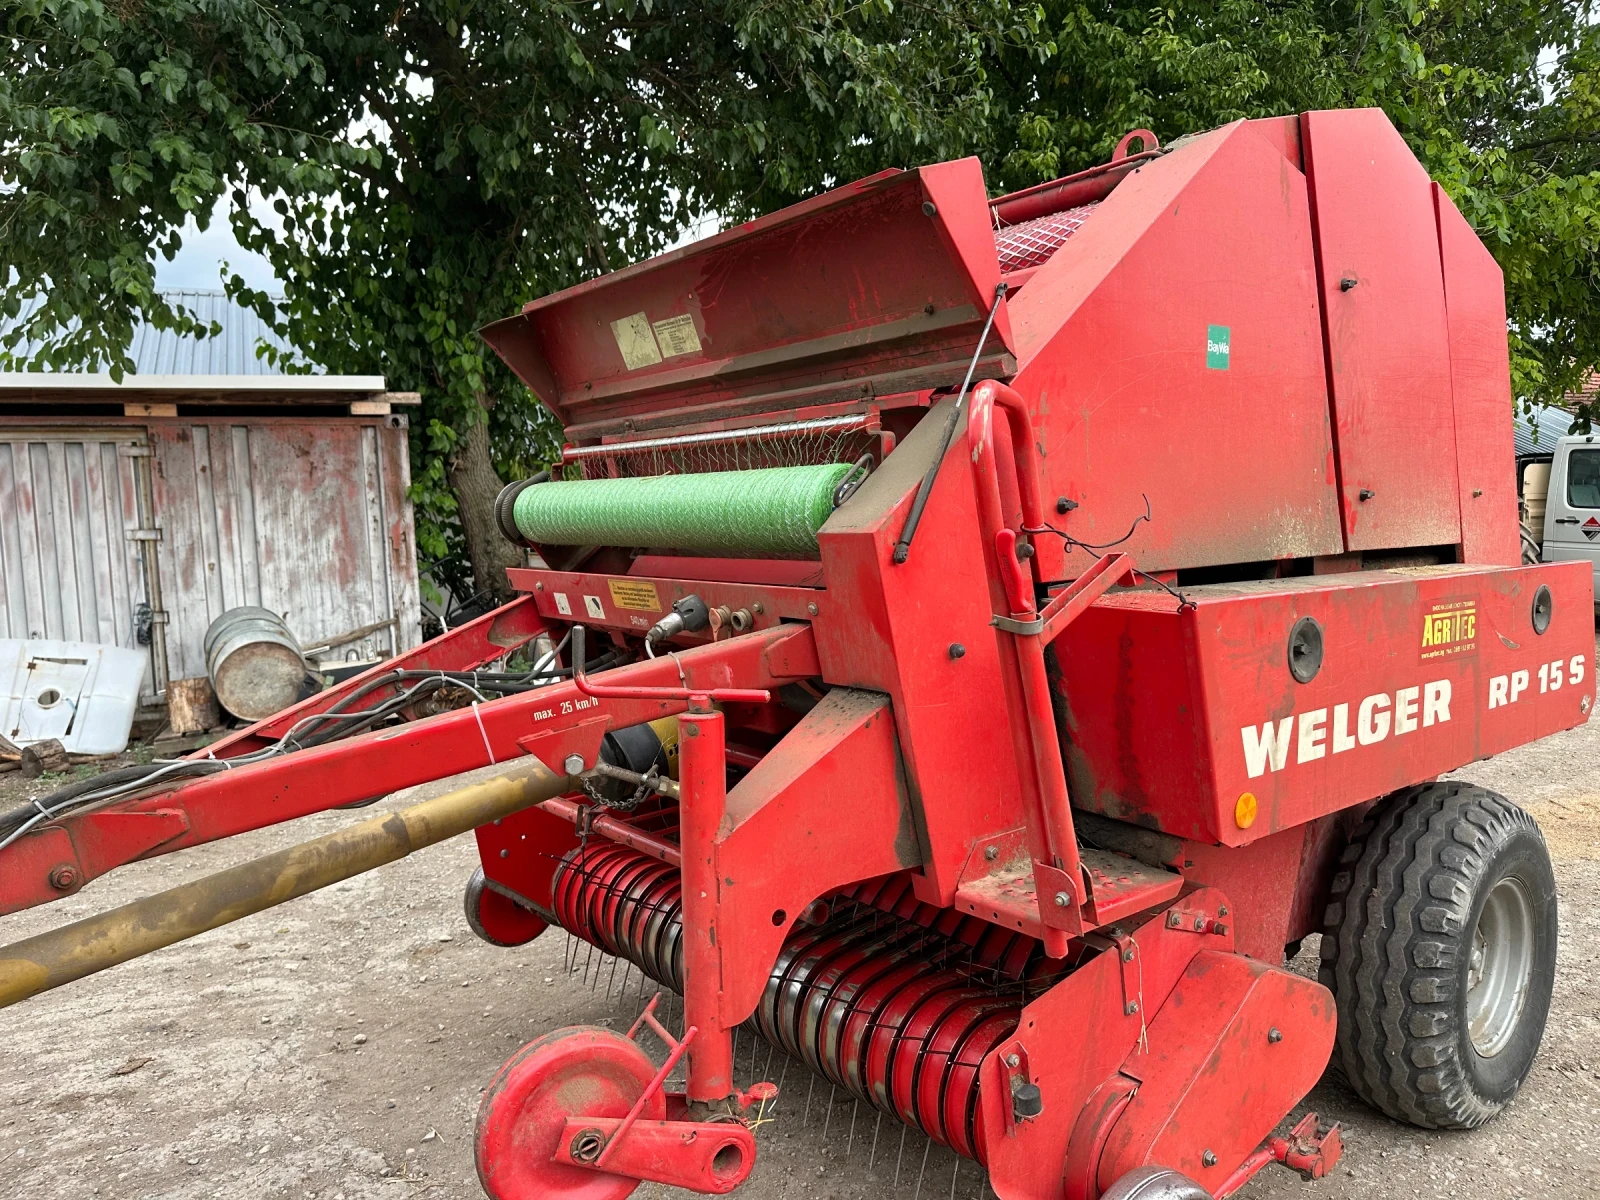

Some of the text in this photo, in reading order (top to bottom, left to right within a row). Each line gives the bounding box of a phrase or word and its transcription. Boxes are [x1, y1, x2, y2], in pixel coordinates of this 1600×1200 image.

[1207, 340, 1230, 355] BayWa
[533, 696, 599, 721] max. 25 km/h
[1241, 654, 1585, 779] WELGER RP 15 S
